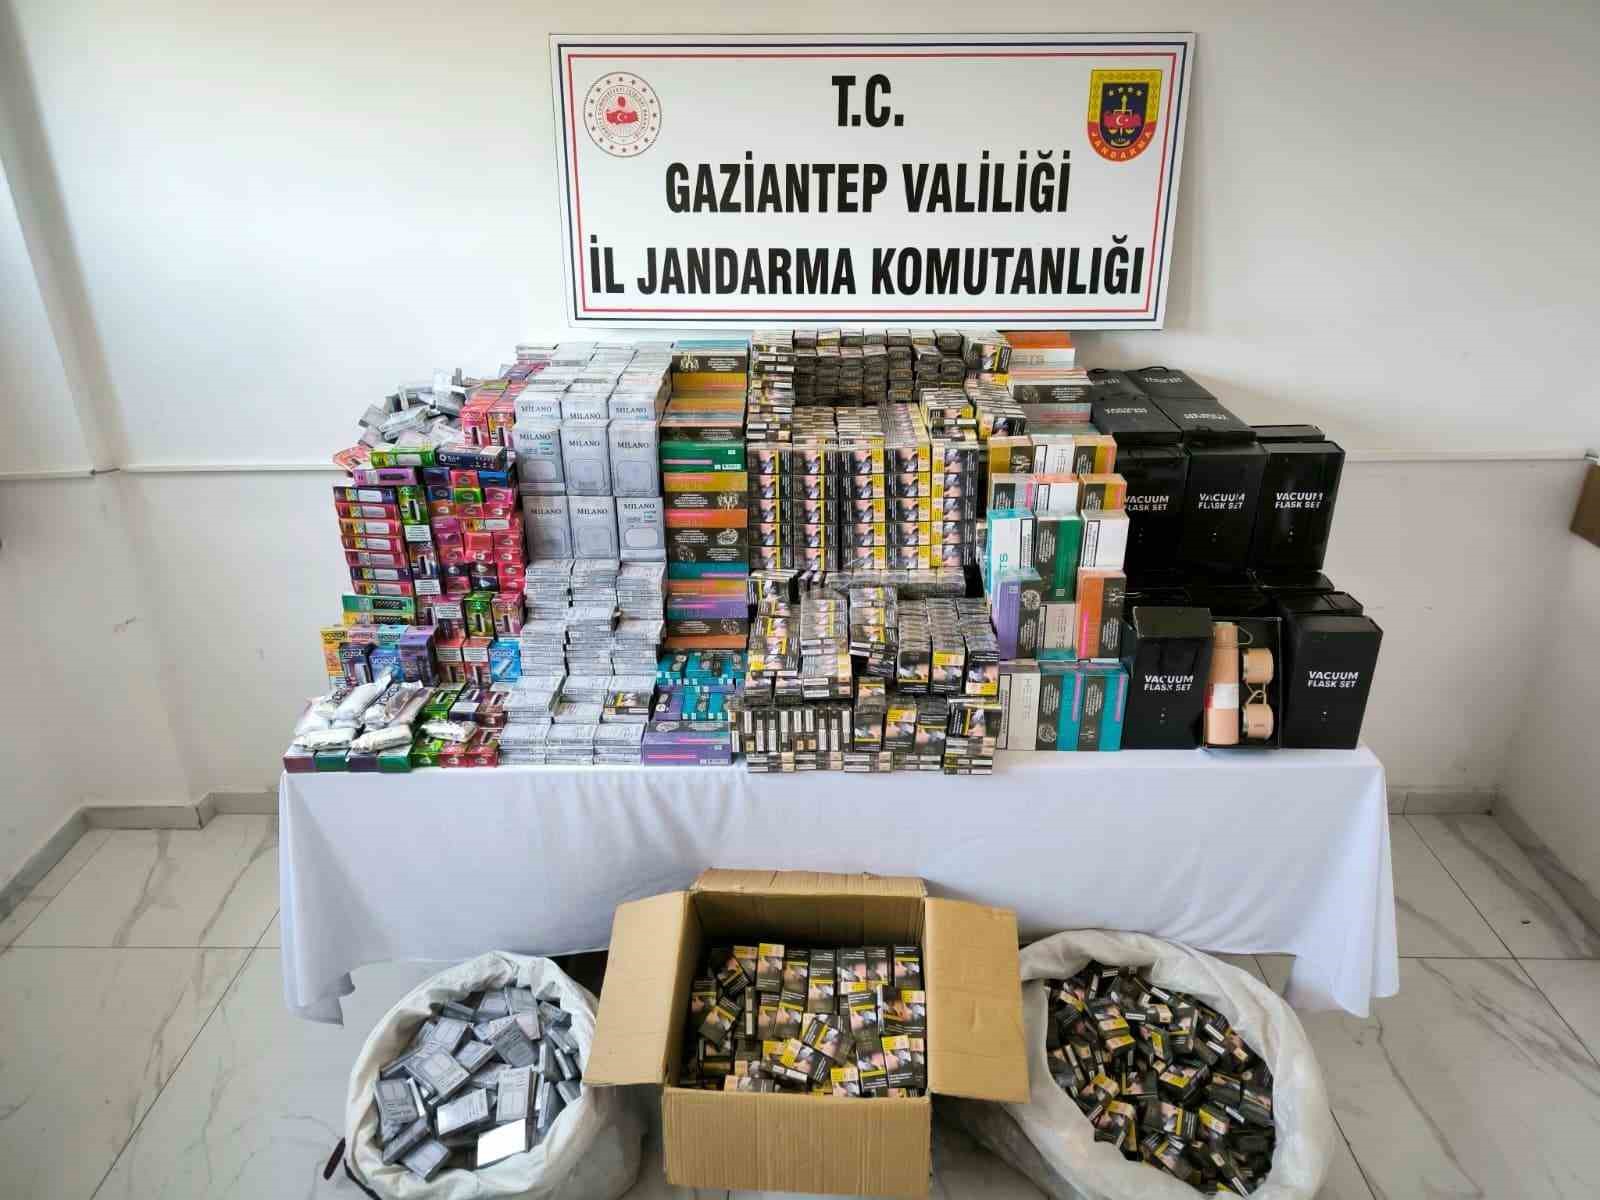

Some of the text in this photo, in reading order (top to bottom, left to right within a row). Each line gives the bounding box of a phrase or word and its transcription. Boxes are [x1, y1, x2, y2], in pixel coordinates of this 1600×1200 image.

[832, 74, 904, 127] T.C.
[667, 150, 1071, 213] GAZİANTEP VALİLİĞİ
[590, 234, 1145, 296] İL JANDARMA KOMUTANLIĞI
[617, 441, 649, 449] MILANO
[1275, 501, 1321, 509] FLASK SET
[1145, 675, 1194, 683] VACUUM
[1309, 671, 1359, 680] VACUUM
[1144, 683, 1192, 691] FLASK SET
[1308, 680, 1356, 688] FLASK SET
